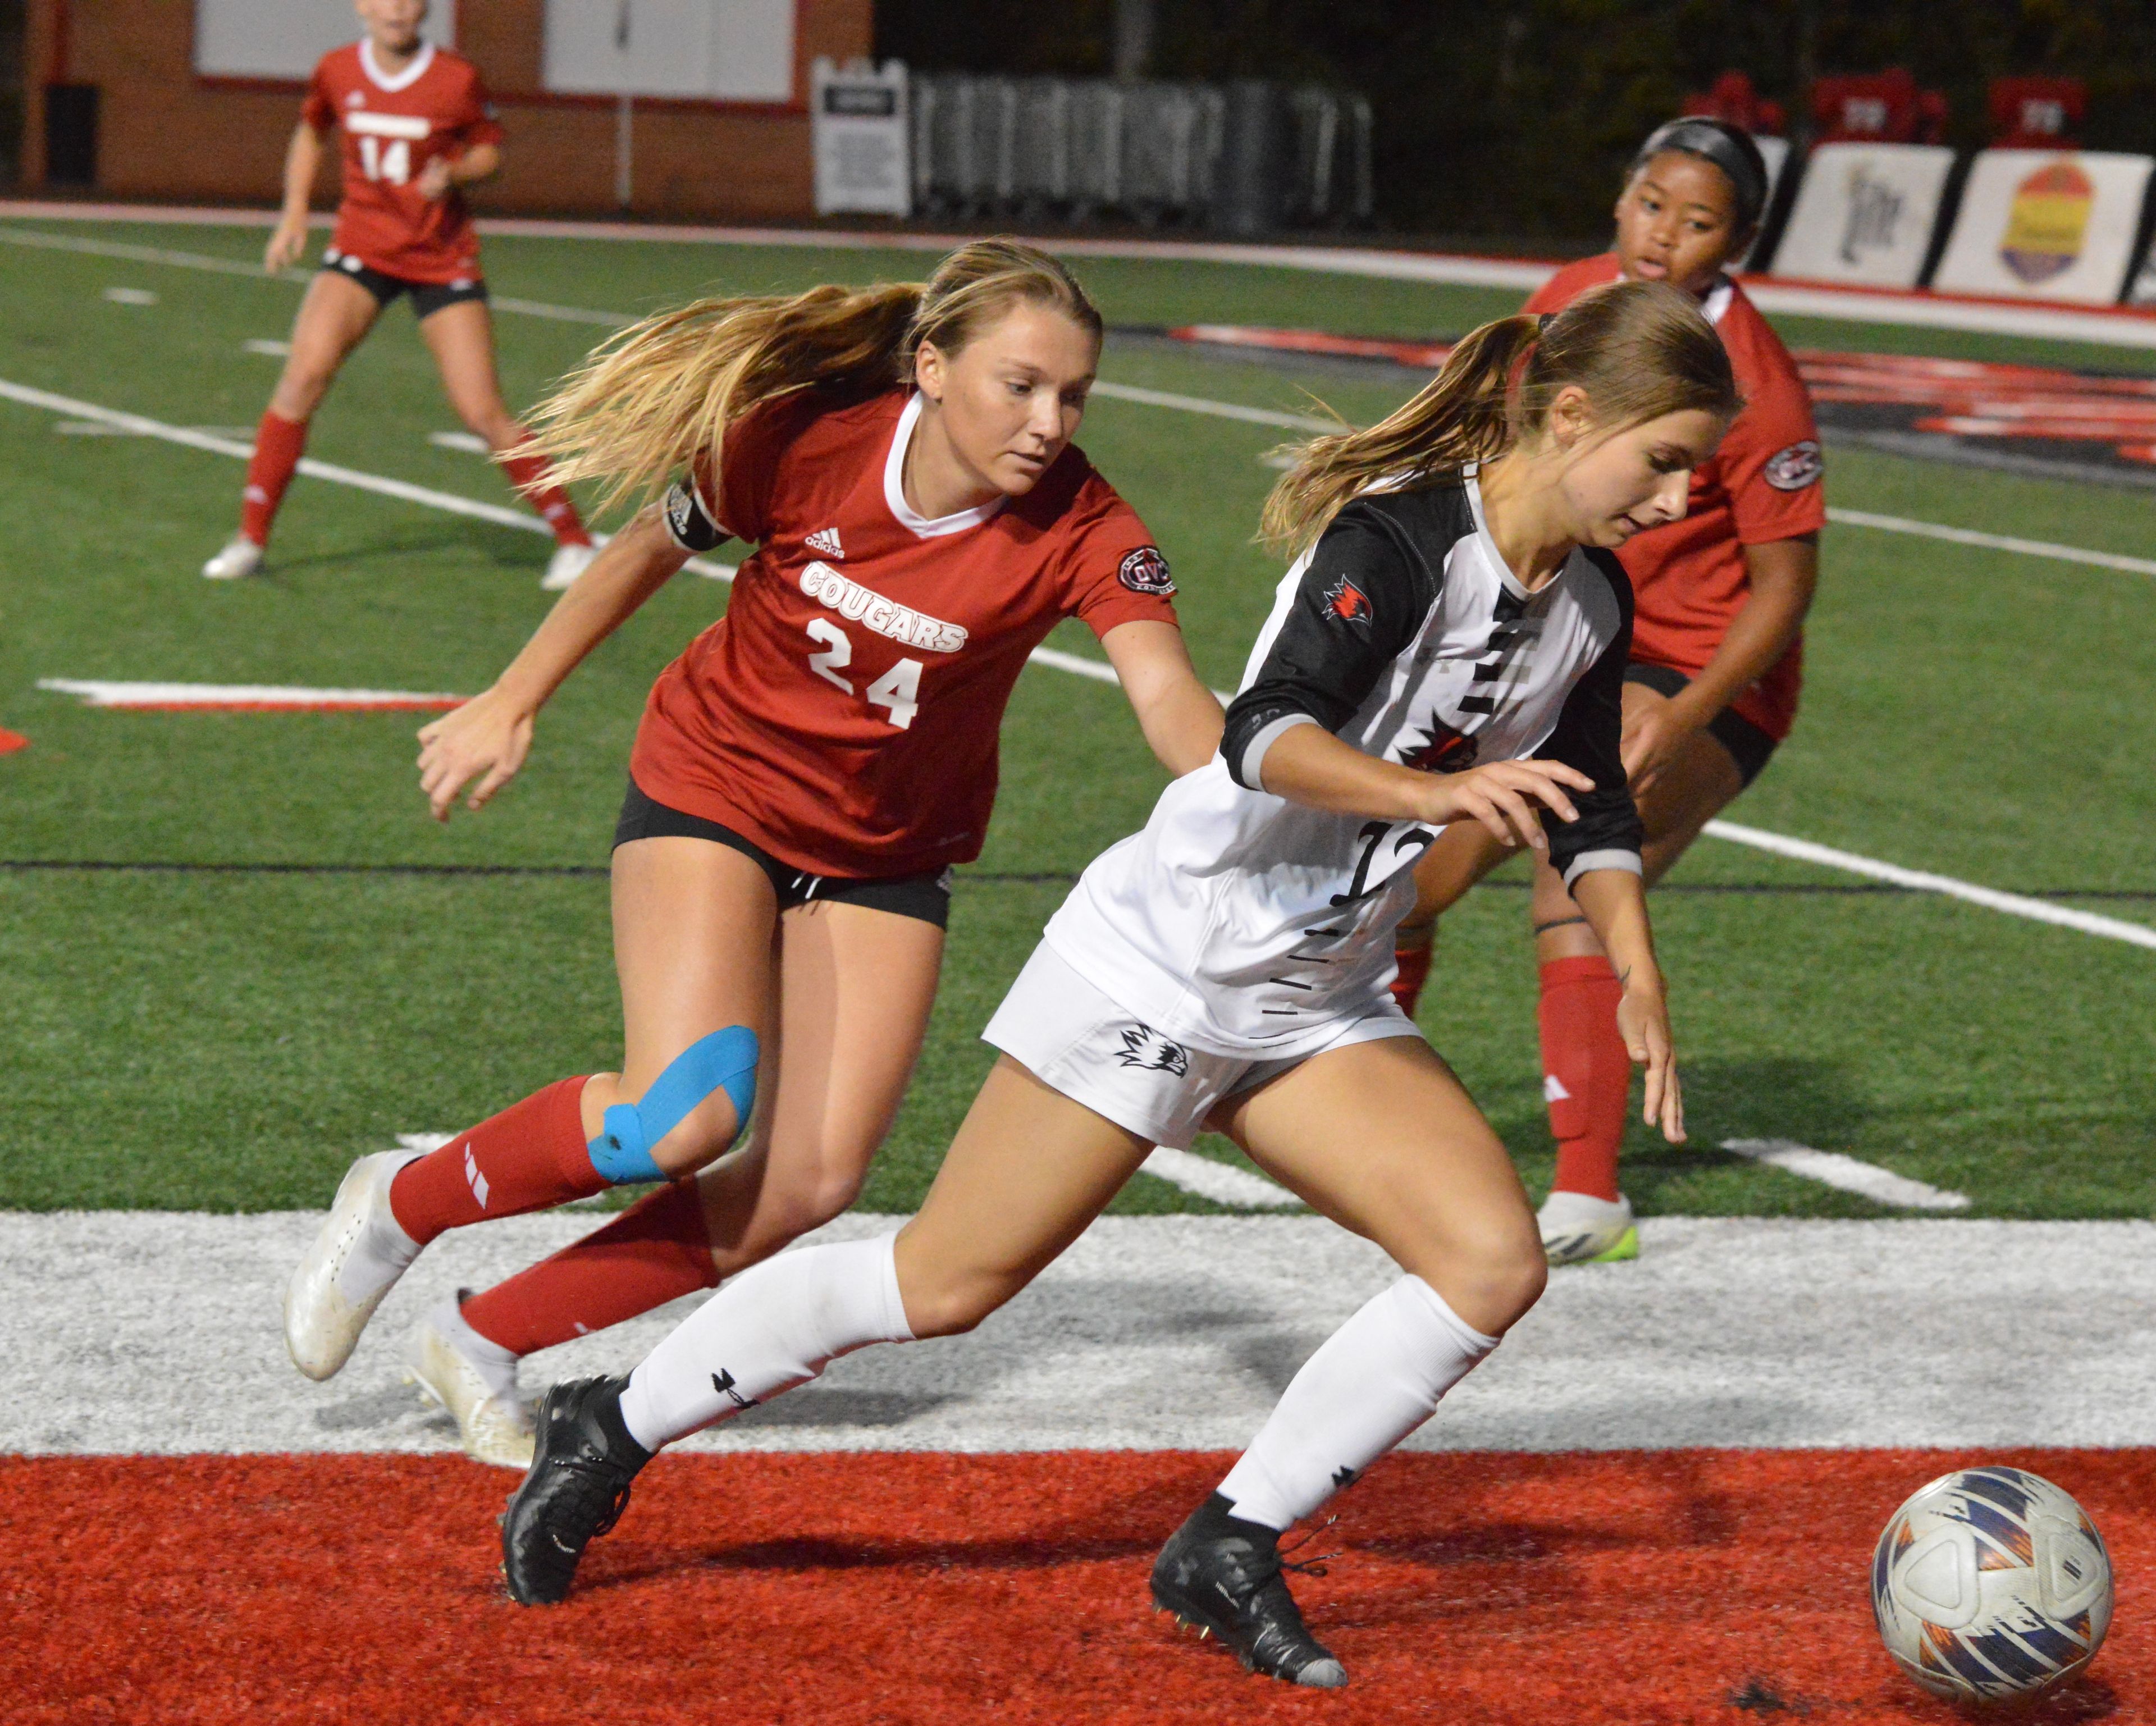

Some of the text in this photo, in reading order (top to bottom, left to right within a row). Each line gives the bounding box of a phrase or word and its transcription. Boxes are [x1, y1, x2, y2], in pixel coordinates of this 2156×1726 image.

[358, 136, 410, 186] 14
[805, 536, 844, 559] adidas
[800, 560, 969, 652] COUGARS
[806, 618, 924, 729] 24
